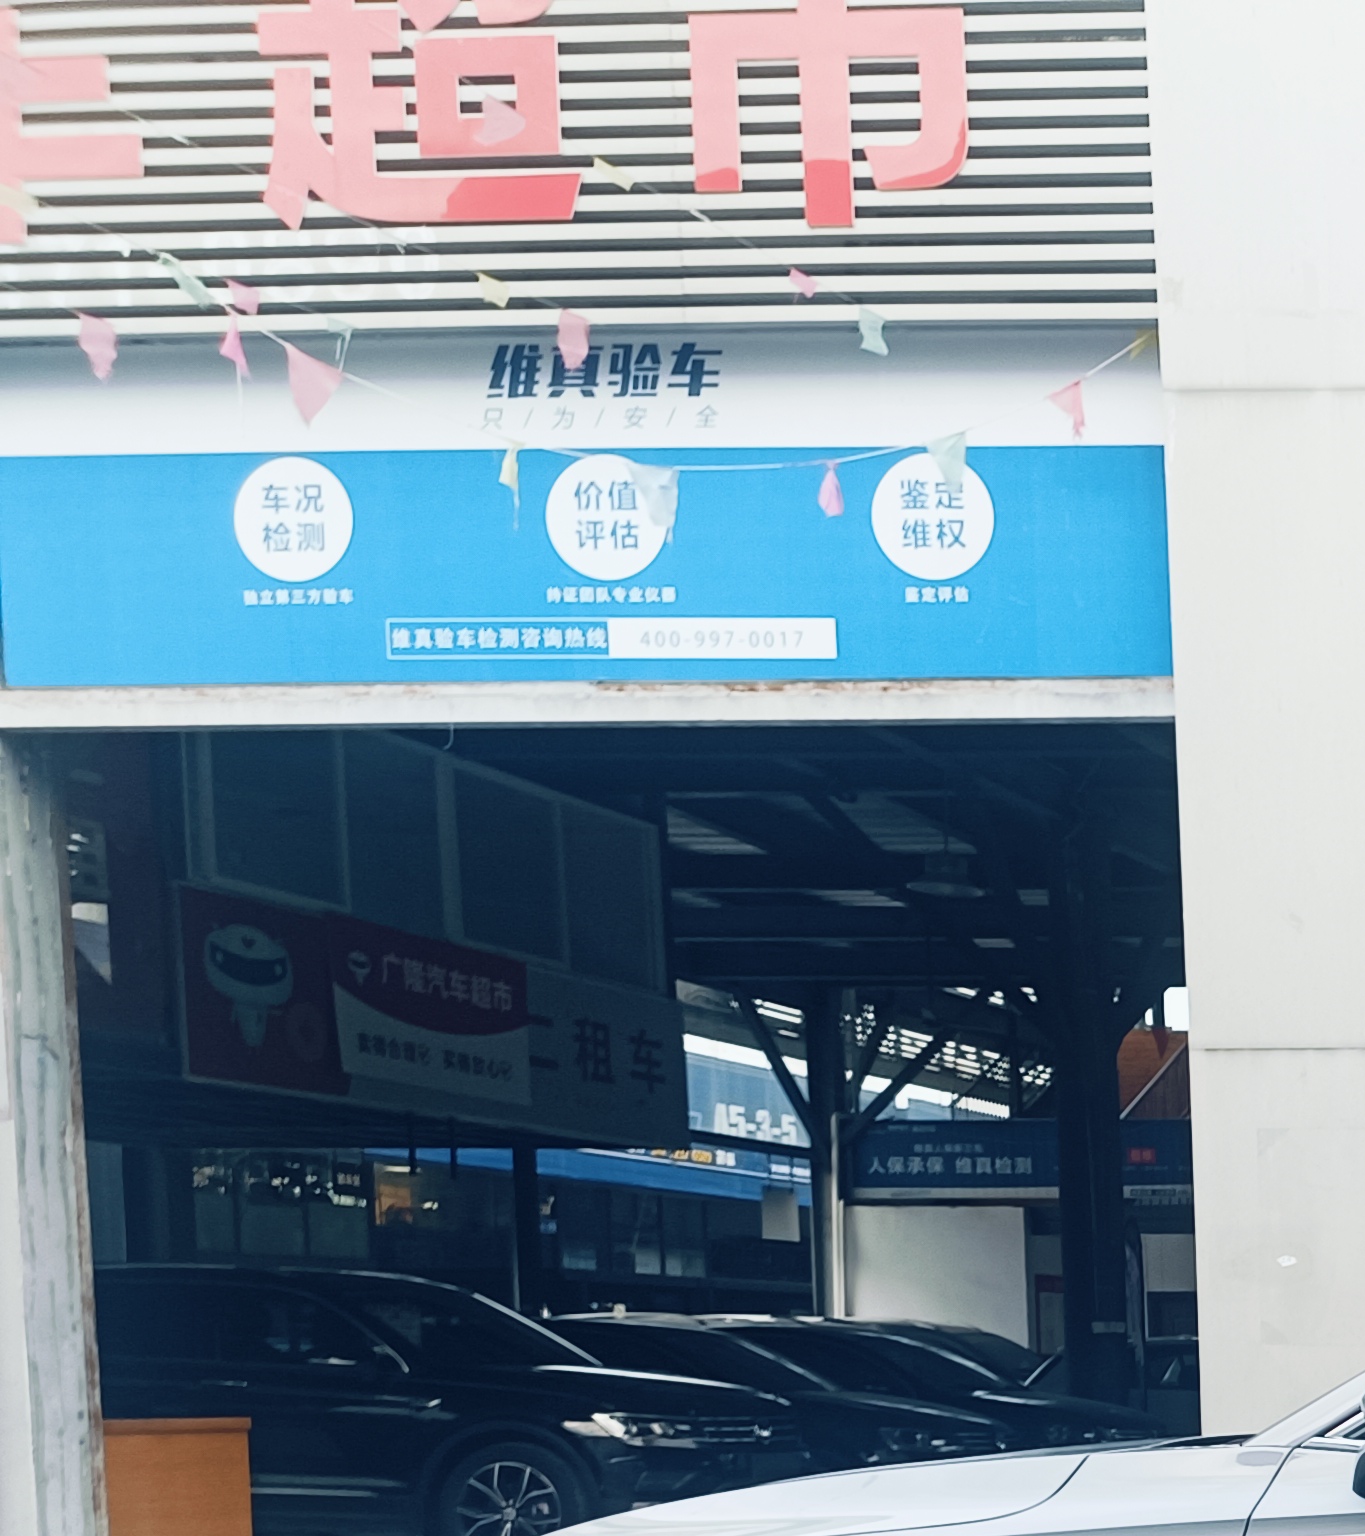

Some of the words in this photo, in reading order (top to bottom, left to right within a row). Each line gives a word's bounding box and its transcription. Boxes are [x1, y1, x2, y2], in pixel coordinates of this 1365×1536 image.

[487, 342, 722, 398] 维真验车
[262, 484, 324, 513] 车况
[574, 480, 638, 511] 价值
[900, 479, 965, 510] 鉴定
[262, 522, 326, 553] 检测
[575, 519, 639, 550] 评估
[902, 518, 966, 549] 维权
[905, 586, 969, 603] 鉴定评估
[640, 630, 804, 648] 400-997-0017
